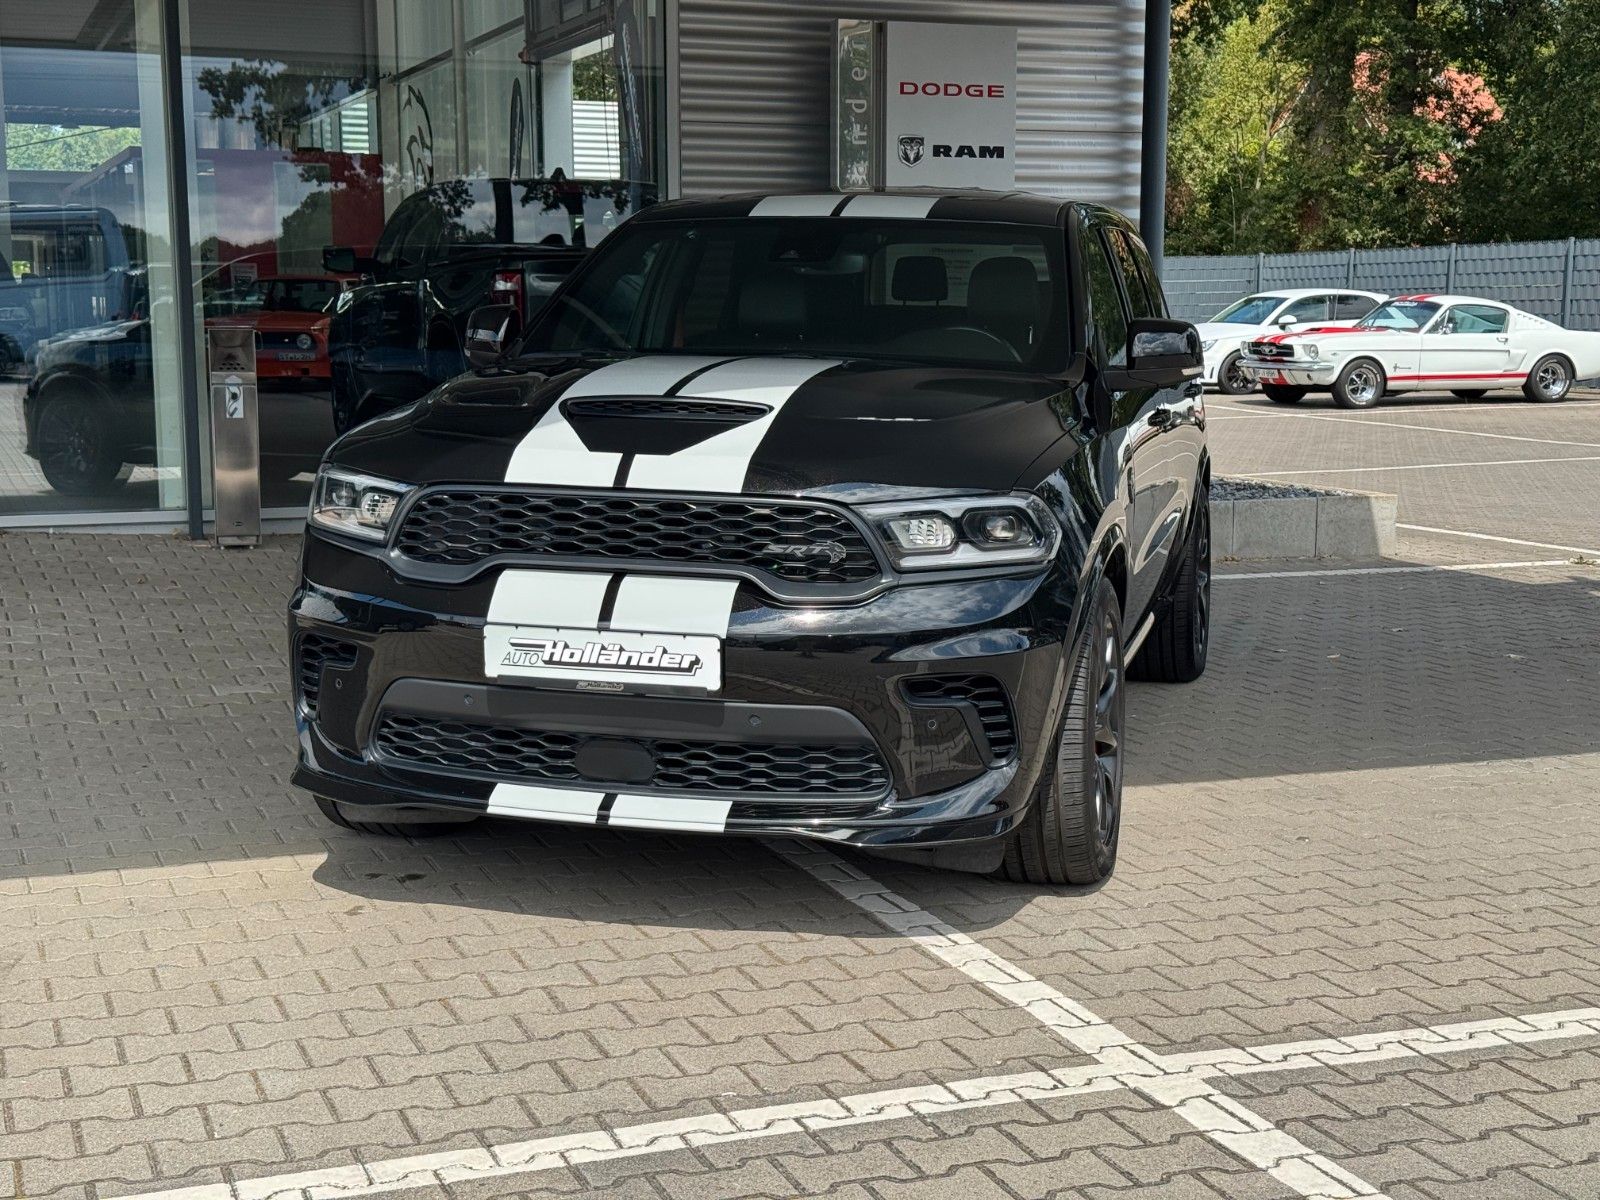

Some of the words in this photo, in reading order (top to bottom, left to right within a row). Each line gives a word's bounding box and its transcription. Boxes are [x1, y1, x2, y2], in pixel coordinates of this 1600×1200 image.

[899, 81, 1005, 98] DODGE
[932, 144, 1005, 159] RAM
[762, 544, 829, 558] SRT
[502, 651, 540, 666] AUTO
[541, 639, 702, 672] Holländer
